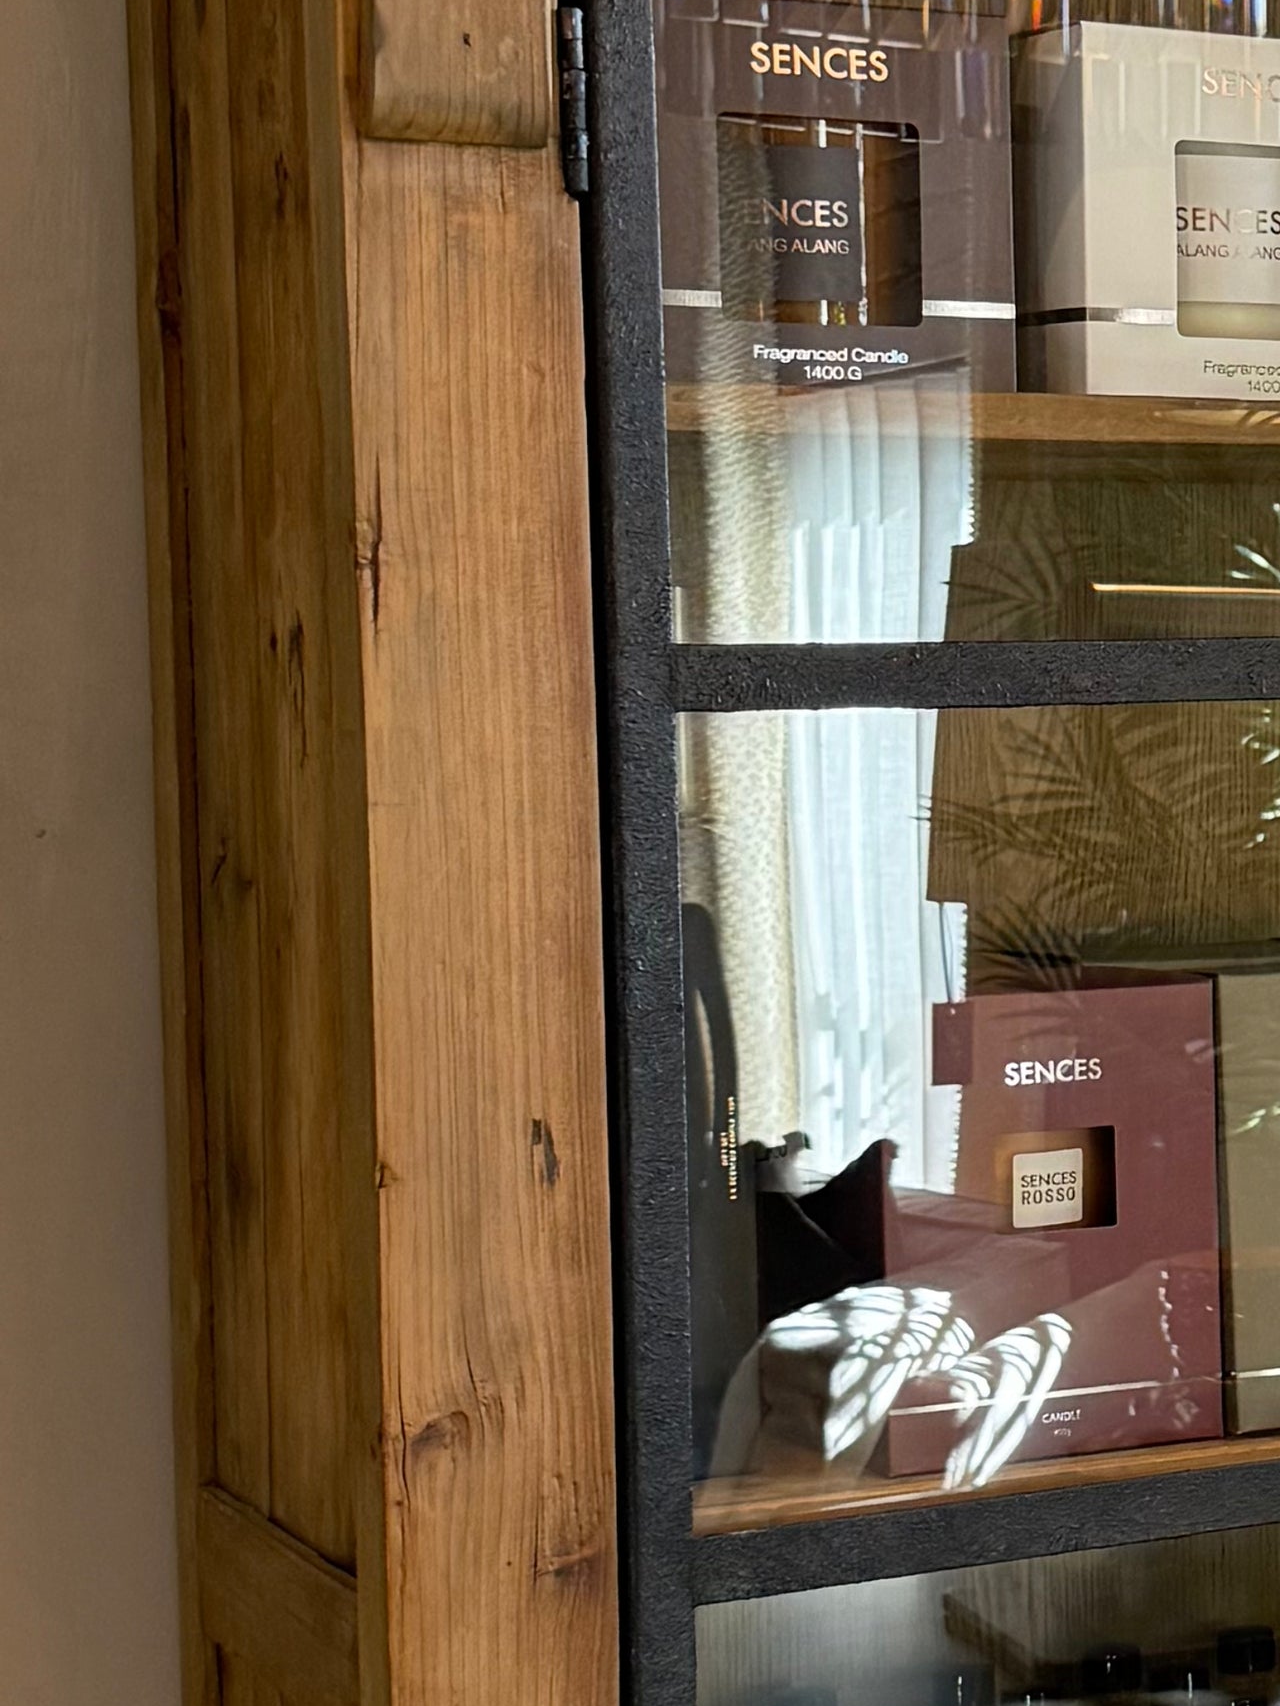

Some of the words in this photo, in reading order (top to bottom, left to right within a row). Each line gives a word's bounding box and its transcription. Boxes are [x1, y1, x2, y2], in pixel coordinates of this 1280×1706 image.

[750, 41, 889, 82] SENCES
[791, 237, 850, 254] ALANG
[1177, 242, 1230, 258] ALANG
[753, 345, 848, 364] Fragranced
[851, 347, 909, 364] Candle
[804, 365, 844, 380] 1400
[847, 366, 862, 381] G
[1004, 1058, 1102, 1086] SENCES
[1021, 1171, 1077, 1188] SENCES
[1021, 1187, 1076, 1205] ROSSO
